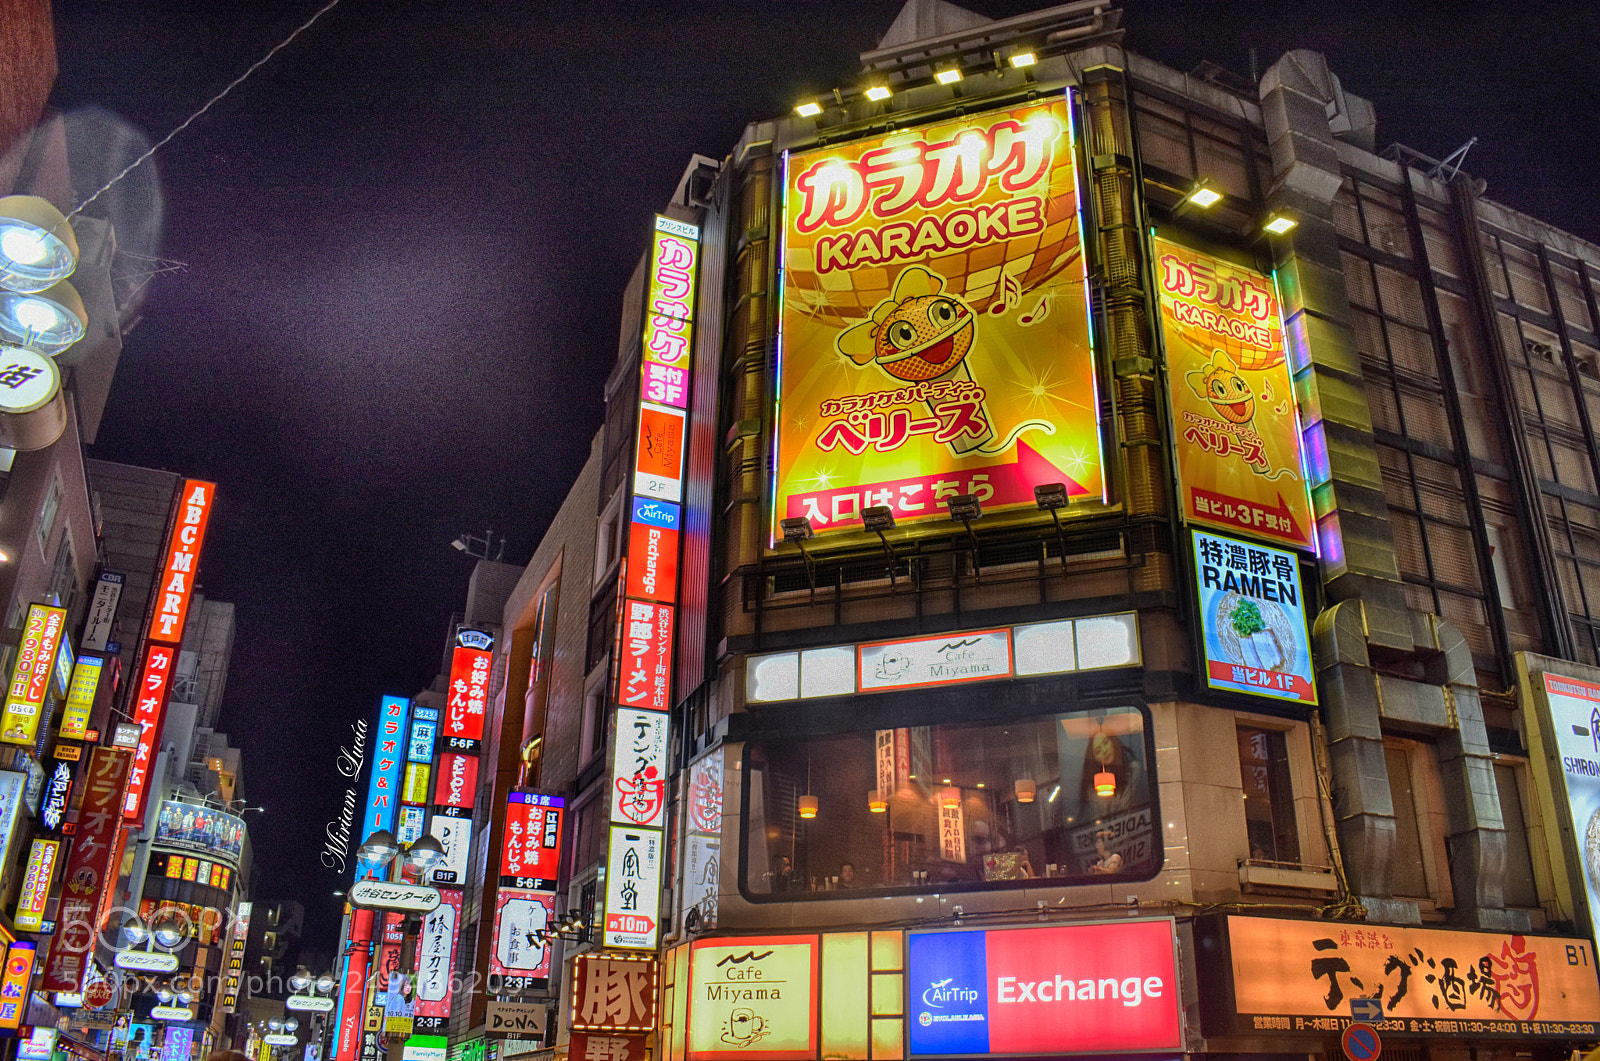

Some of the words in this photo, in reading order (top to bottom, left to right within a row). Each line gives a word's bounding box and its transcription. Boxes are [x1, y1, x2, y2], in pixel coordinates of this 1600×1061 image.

[797, 114, 1060, 233] カラオケ
[658, 219, 695, 236] プリンスビル
[817, 198, 1046, 274] KARAOKE
[648, 238, 694, 364] カラオケ
[1161, 254, 1272, 320] カラオケ
[1174, 299, 1272, 350] KARAOKE
[648, 383, 683, 403] 3F
[650, 364, 683, 385] 受付
[816, 387, 993, 455] ベリーズ
[653, 431, 664, 454] Cafe
[663, 423, 676, 469] Miyama
[1183, 425, 1269, 468] ベリーズ
[649, 480, 666, 493] 2F
[801, 473, 995, 526] 入口はこちら
[643, 508, 675, 524] AirTrip
[1194, 495, 1292, 534] 当ビル3F受付
[160, 486, 206, 635] ABC-MART
[642, 528, 661, 595] Exchange
[1200, 537, 1294, 582] 特濃豚骨
[1202, 564, 1298, 607] RAMEN
[28, 613, 62, 700] 全身もみほぐし
[625, 602, 654, 704] 野郎ラーメン
[654, 606, 670, 676] 渋谷センター街
[945, 649, 976, 662] Cafe
[466, 655, 489, 715] お好み焼
[930, 660, 991, 679] Miyama
[1231, 666, 1272, 687] 当ビル
[1275, 675, 1294, 690] 1F
[450, 678, 468, 733] もんじゃ
[85, 731, 98, 740] 4F
[414, 726, 430, 756] 麻雀
[78, 751, 125, 863] カラオケ
[445, 806, 461, 817] 4F
[64, 824, 77, 833] 3F
[523, 806, 543, 866] お好み焼
[543, 811, 558, 848] 江戸前
[507, 820, 524, 875] もんじゃ
[436, 871, 455, 881] B1F
[620, 833, 647, 911] 一風堂
[356, 887, 437, 903] 渋谷センター街
[42, 921, 55, 933] 2F
[609, 915, 649, 933] 約10m
[1339, 929, 1394, 950] 東京渋谷
[508, 926, 521, 965] お食事
[1564, 944, 1588, 967] B1
[580, 959, 649, 1025] 豚
[725, 966, 763, 981] Cafe
[996, 973, 1164, 1007] Exchange
[0, 981, 23, 1019] 松屋
[706, 984, 782, 1004] Miyama
[931, 986, 978, 1005] AirTrip
[506, 1032, 522, 1040] B1F
[1253, 1016, 1291, 1031] 営業時間
[411, 1050, 444, 1059] FamilyMart
